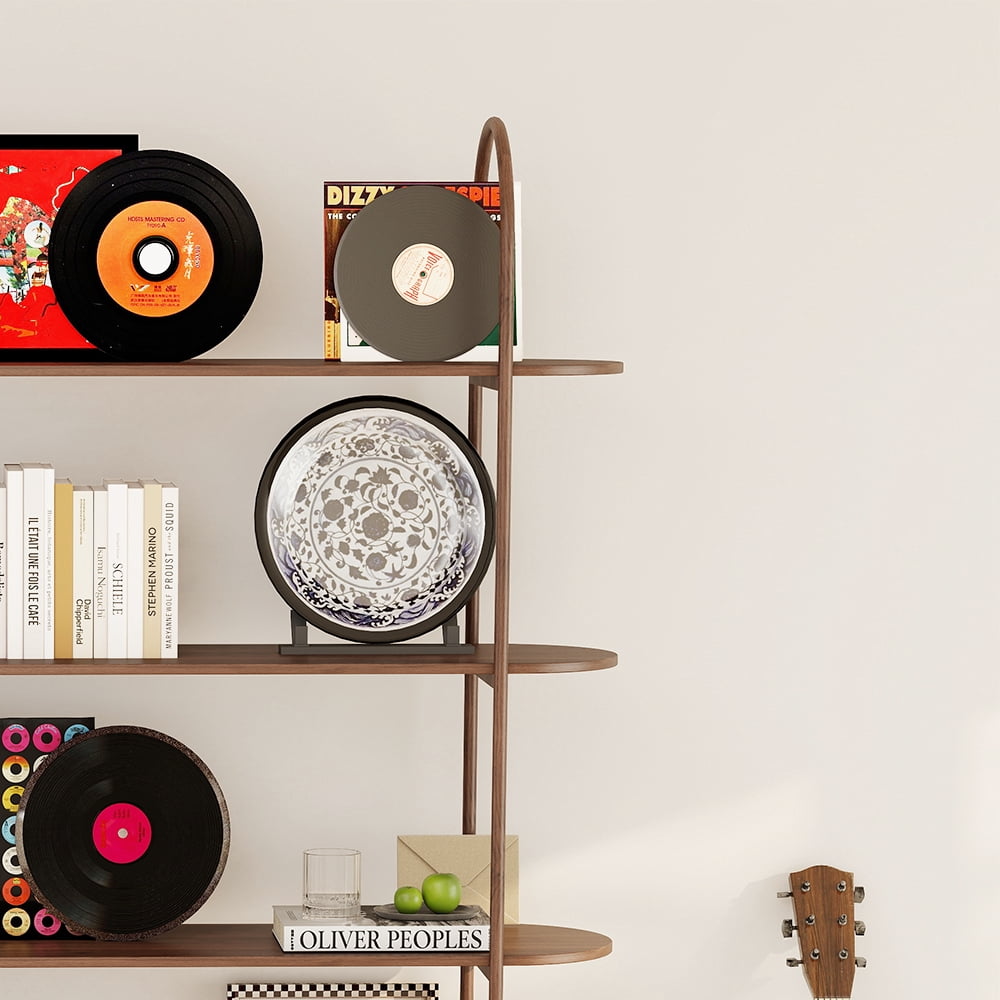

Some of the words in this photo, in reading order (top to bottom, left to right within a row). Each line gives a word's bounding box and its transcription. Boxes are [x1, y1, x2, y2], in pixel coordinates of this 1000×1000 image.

[165, 502, 174, 531] SQUID
[28, 527, 41, 550] ÉTAIT
[148, 527, 156, 567] MARINO
[28, 553, 39, 569] UNE
[165, 553, 174, 589] PROUST
[28, 572, 39, 590] FOIS
[112, 562, 123, 616] SCHIELE
[148, 570, 156, 616] STEPHEN
[28, 592, 39, 602] LE
[28, 604, 41, 626] CAFÉ
[75, 599, 84, 645] Chipperfield
[300, 930, 380, 949] OLIVER
[387, 930, 482, 949] PEOPLES
